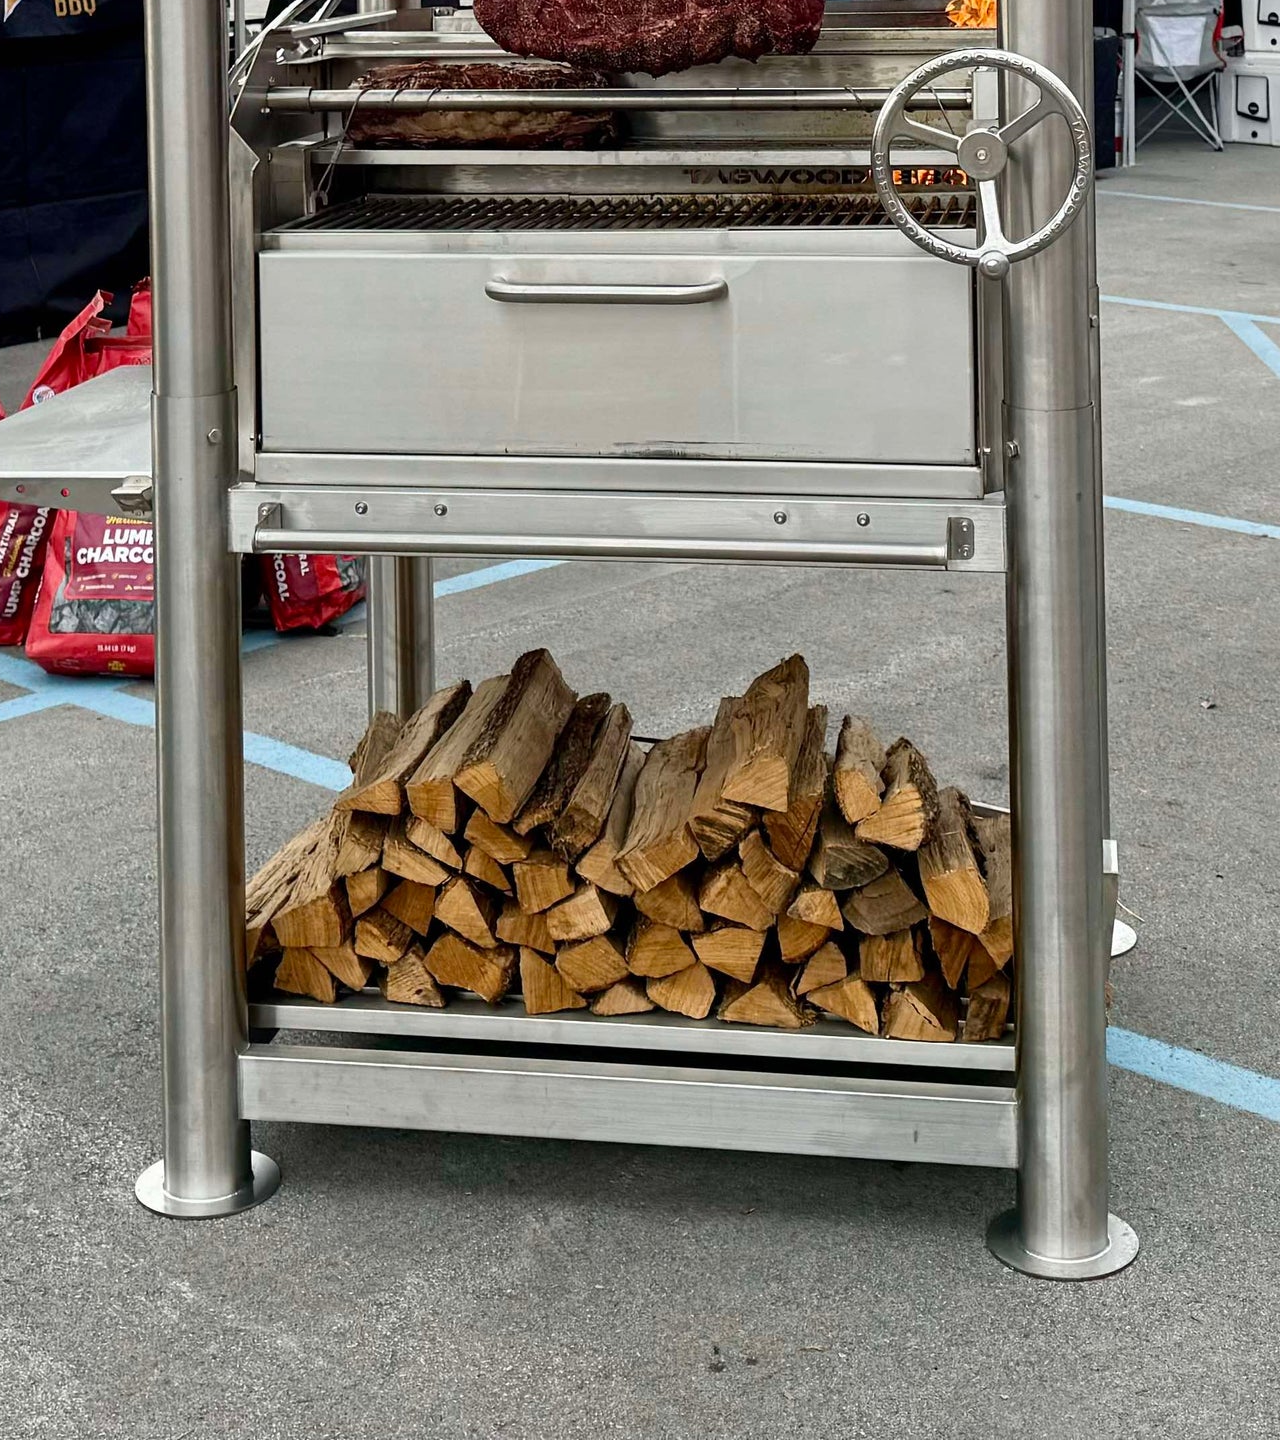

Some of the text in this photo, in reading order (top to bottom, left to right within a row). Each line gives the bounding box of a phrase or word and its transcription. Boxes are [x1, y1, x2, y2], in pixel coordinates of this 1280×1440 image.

[682, 167, 871, 186] TAGWOOD
[1, 506, 51, 618] LUMP CHARCOA
[76, 546, 154, 565] CHARCO
[273, 552, 290, 603] RCOAL
